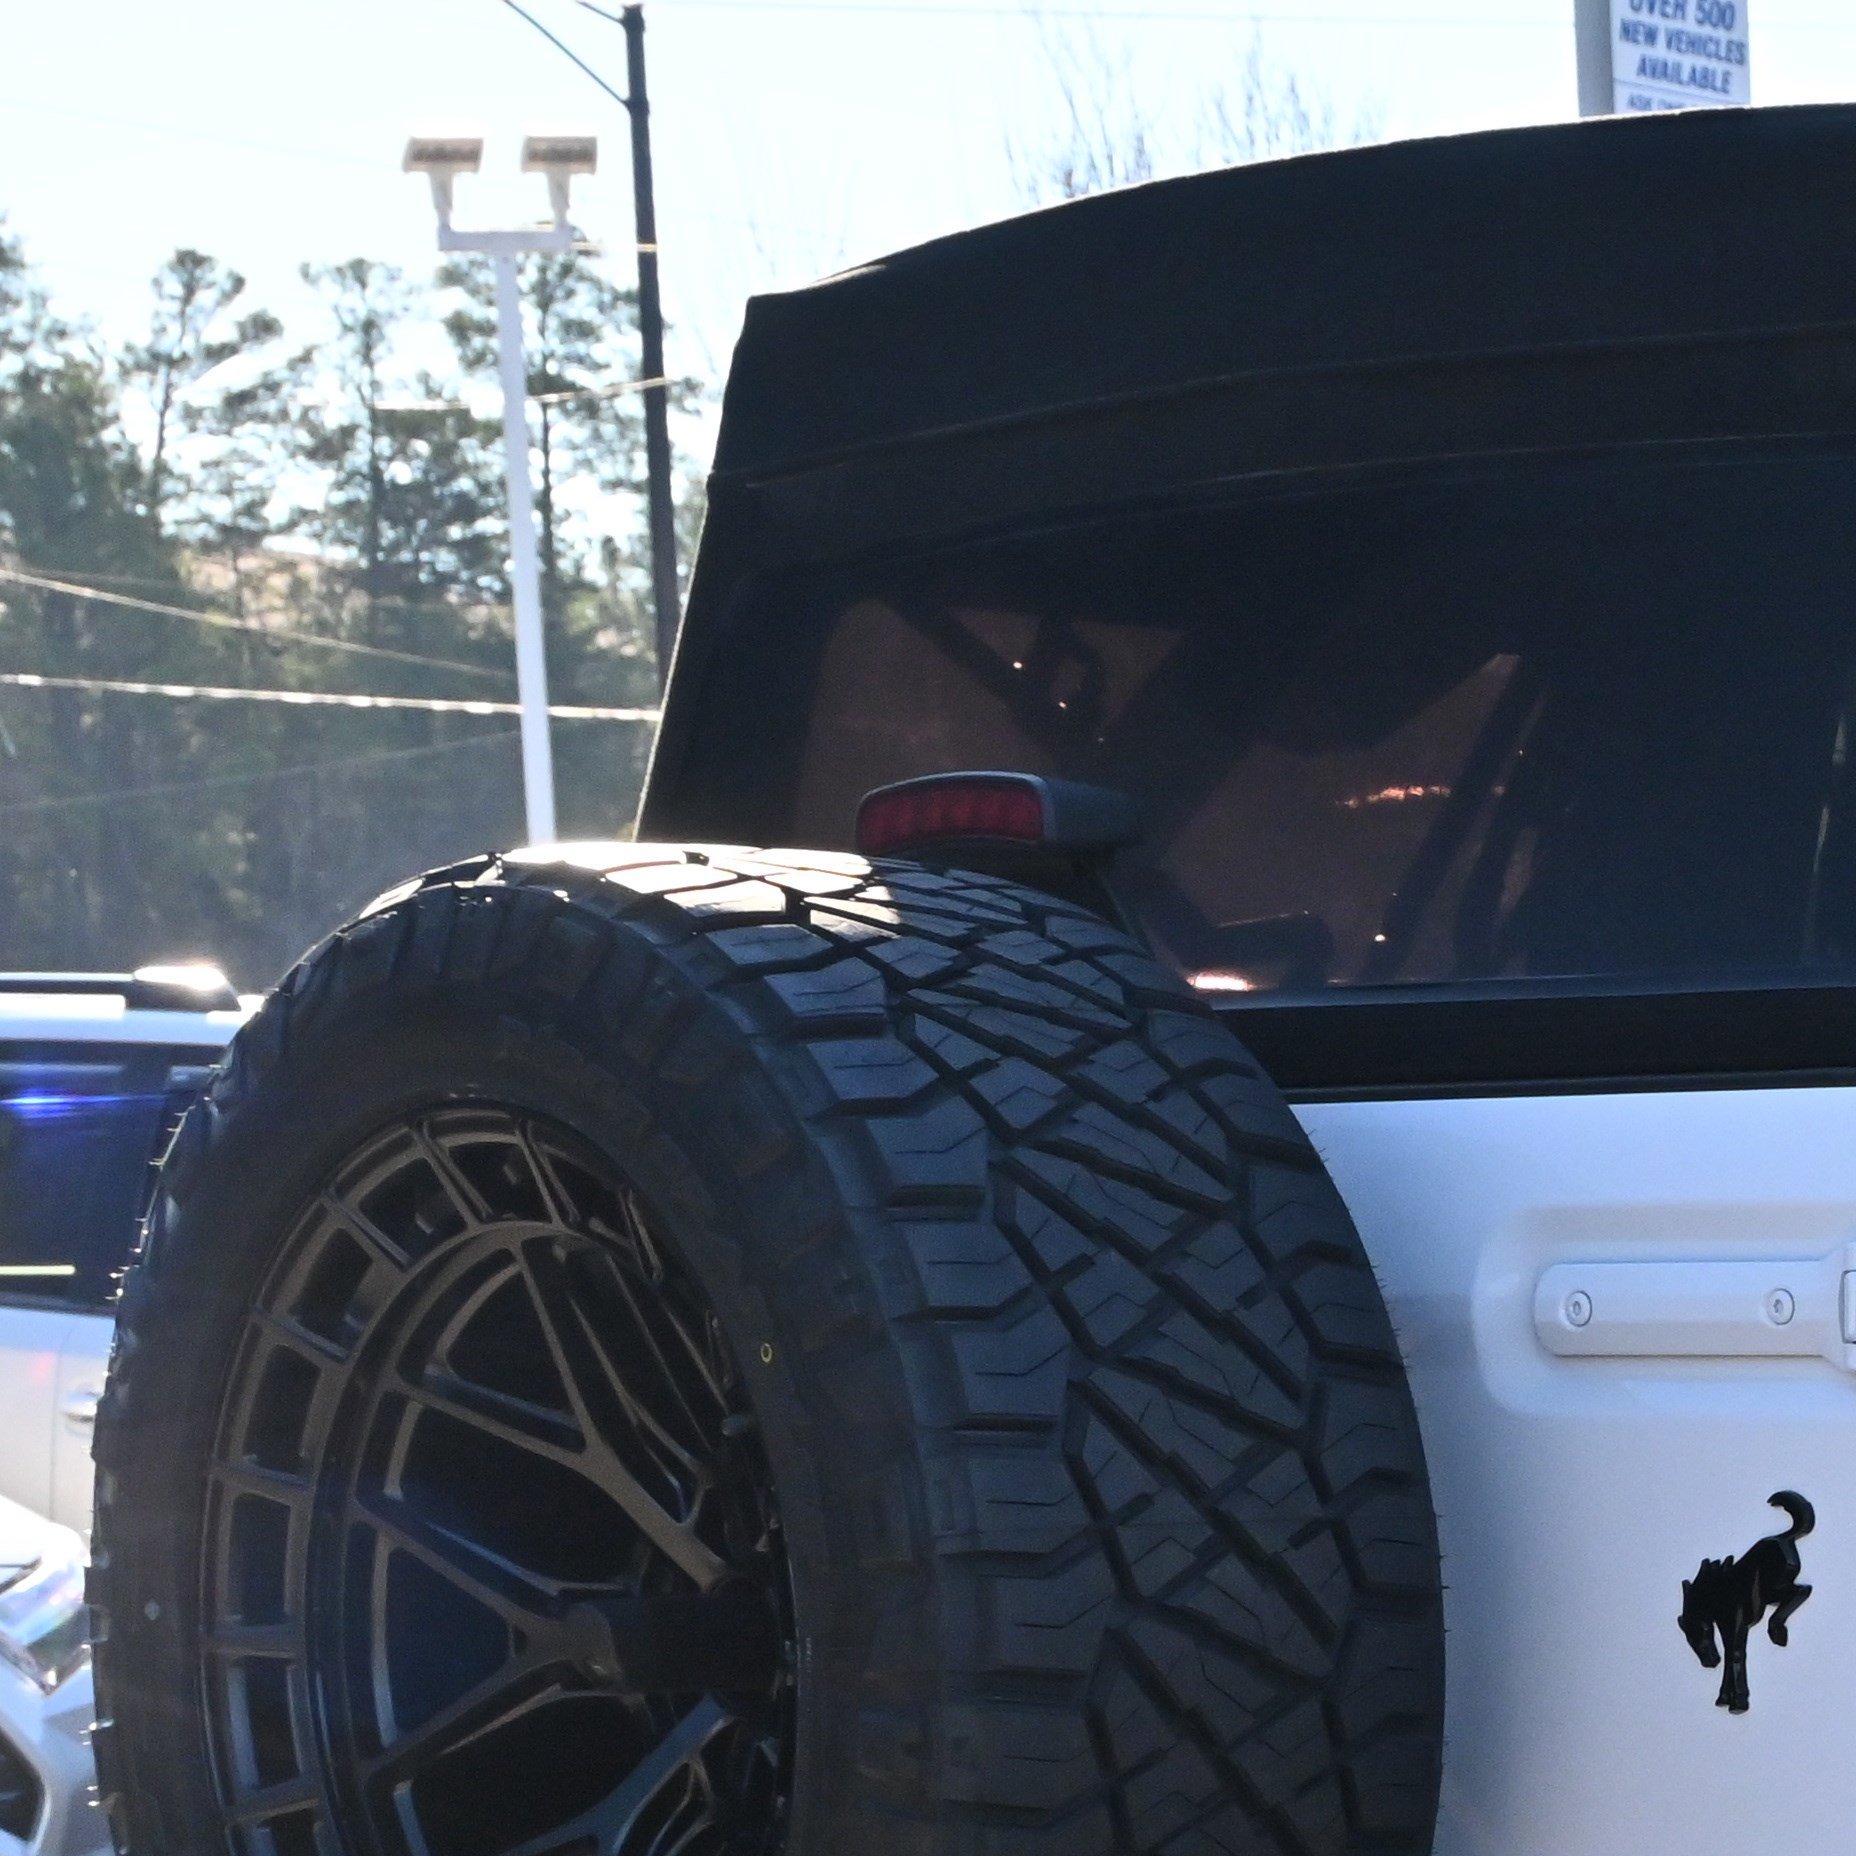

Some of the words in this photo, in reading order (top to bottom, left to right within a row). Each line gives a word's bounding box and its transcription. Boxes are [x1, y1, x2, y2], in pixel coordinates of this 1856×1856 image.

[1694, 0, 1735, 30] 500
[1621, 19, 1658, 46] NEW
[1665, 28, 1745, 65] VEHICLES
[1637, 55, 1731, 94] AVAILABLE
